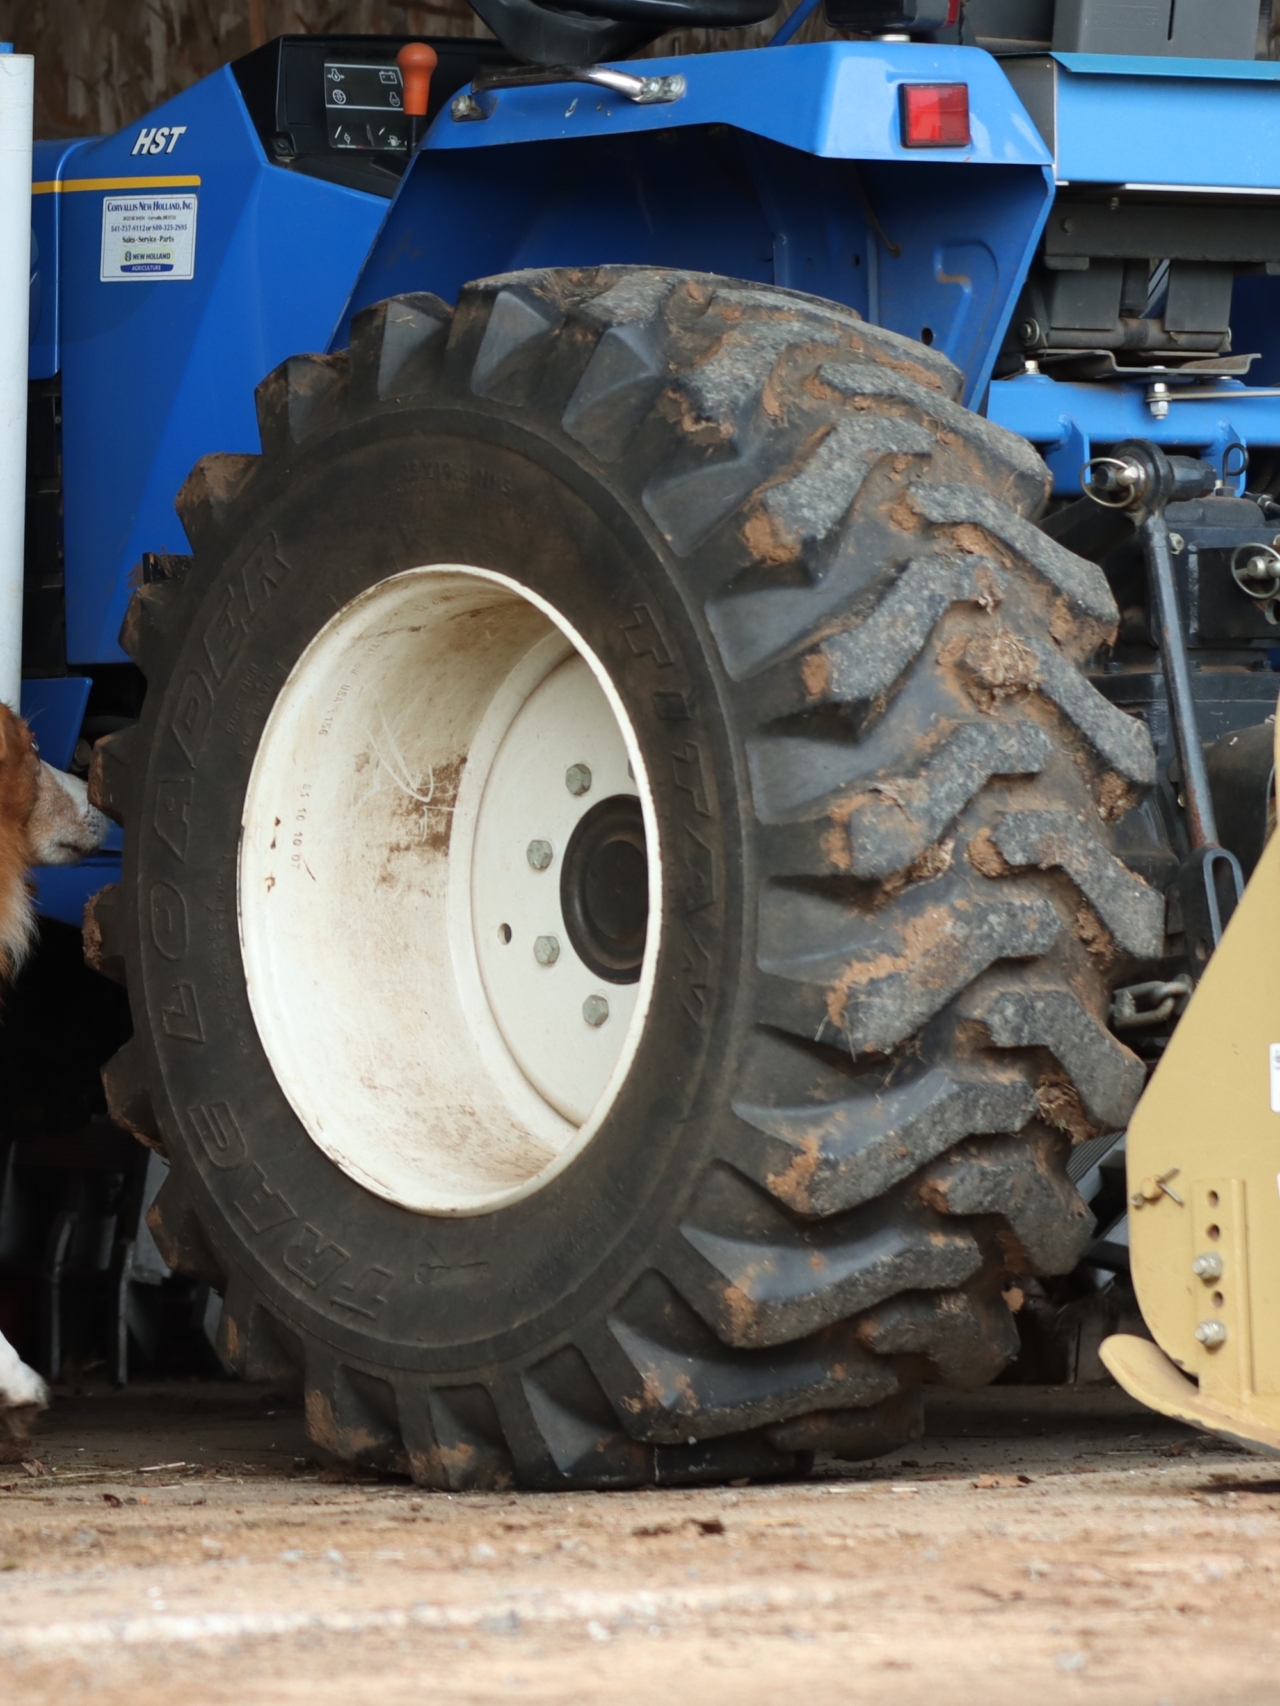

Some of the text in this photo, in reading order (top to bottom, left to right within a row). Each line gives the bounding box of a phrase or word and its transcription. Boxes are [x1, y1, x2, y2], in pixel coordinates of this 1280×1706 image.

[131, 126, 187, 155] HST
[139, 202, 151, 211] NEW
[150, 529, 395, 1320] TRAC LOADER
[623, 602, 714, 1026] TITAN
